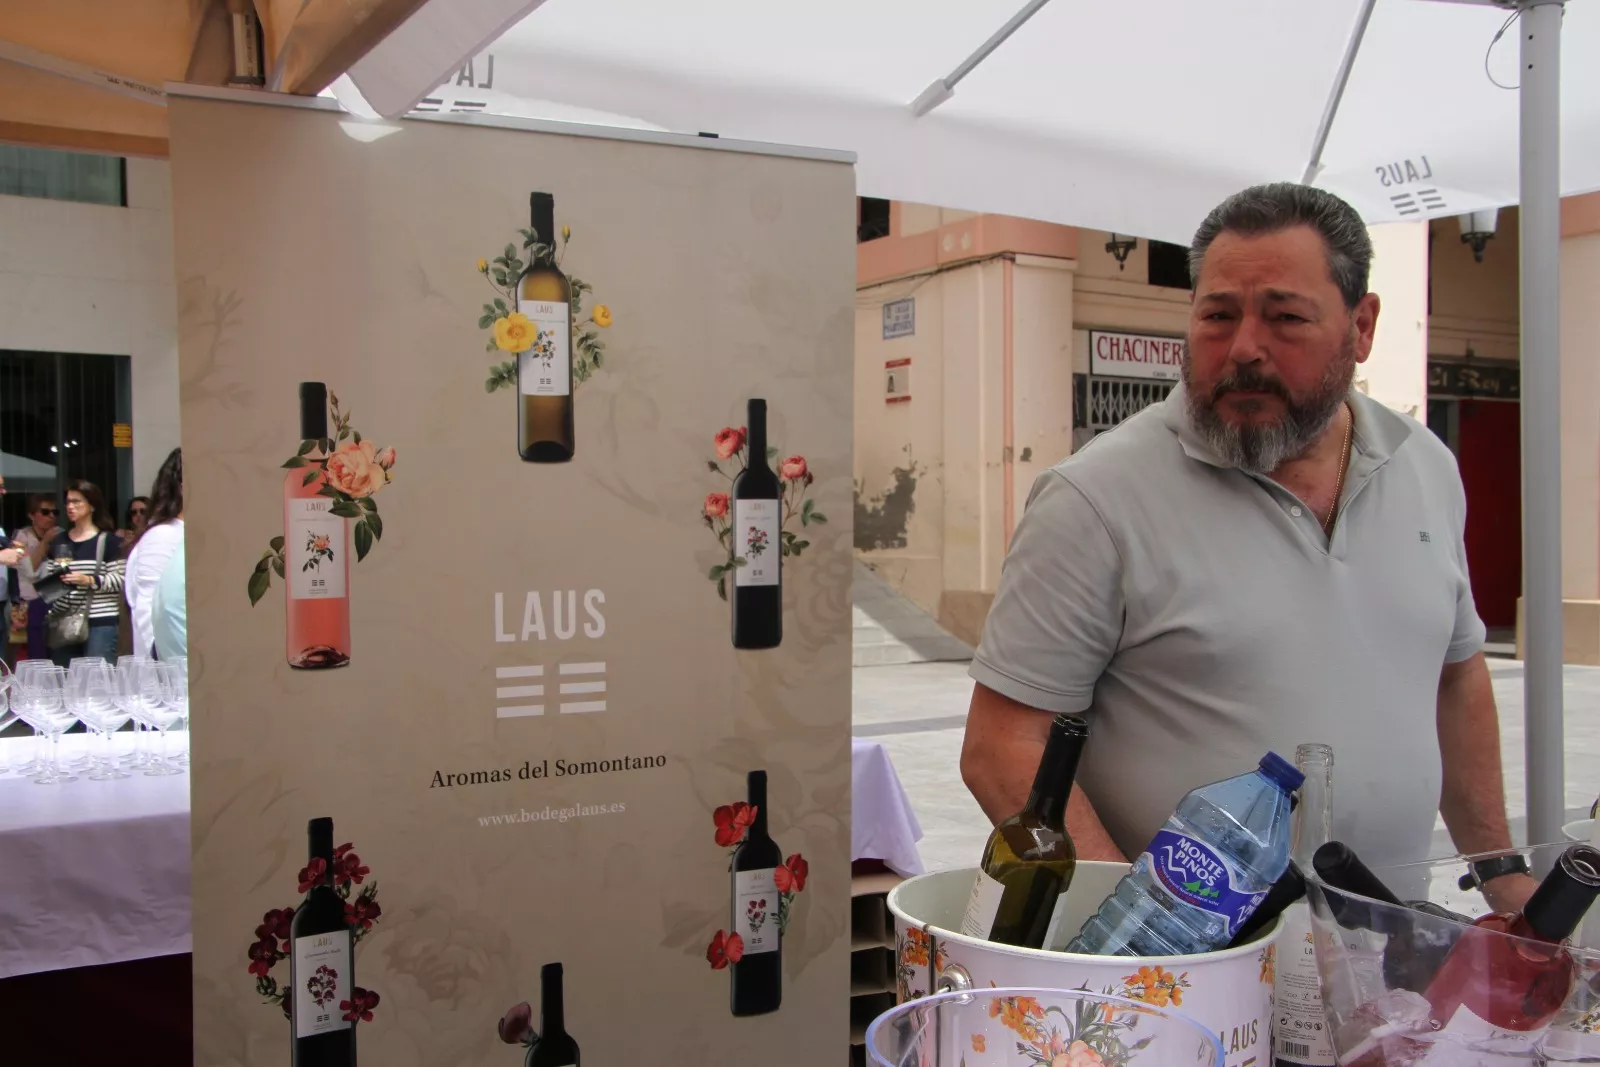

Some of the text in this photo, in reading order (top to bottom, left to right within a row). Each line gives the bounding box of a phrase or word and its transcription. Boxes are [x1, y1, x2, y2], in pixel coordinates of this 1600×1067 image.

[536, 304, 554, 314] LAUS
[1097, 335, 1182, 365] CHACINER
[306, 503, 326, 511] LAUS
[495, 588, 606, 642] LAUS
[430, 752, 667, 788] Aromas del Somontano
[478, 802, 626, 827] www.bodegalaus.es
[1175, 850, 1216, 886] PINOS
[1177, 837, 1224, 878] MONTE
[1220, 1018, 1258, 1056] LAUS
